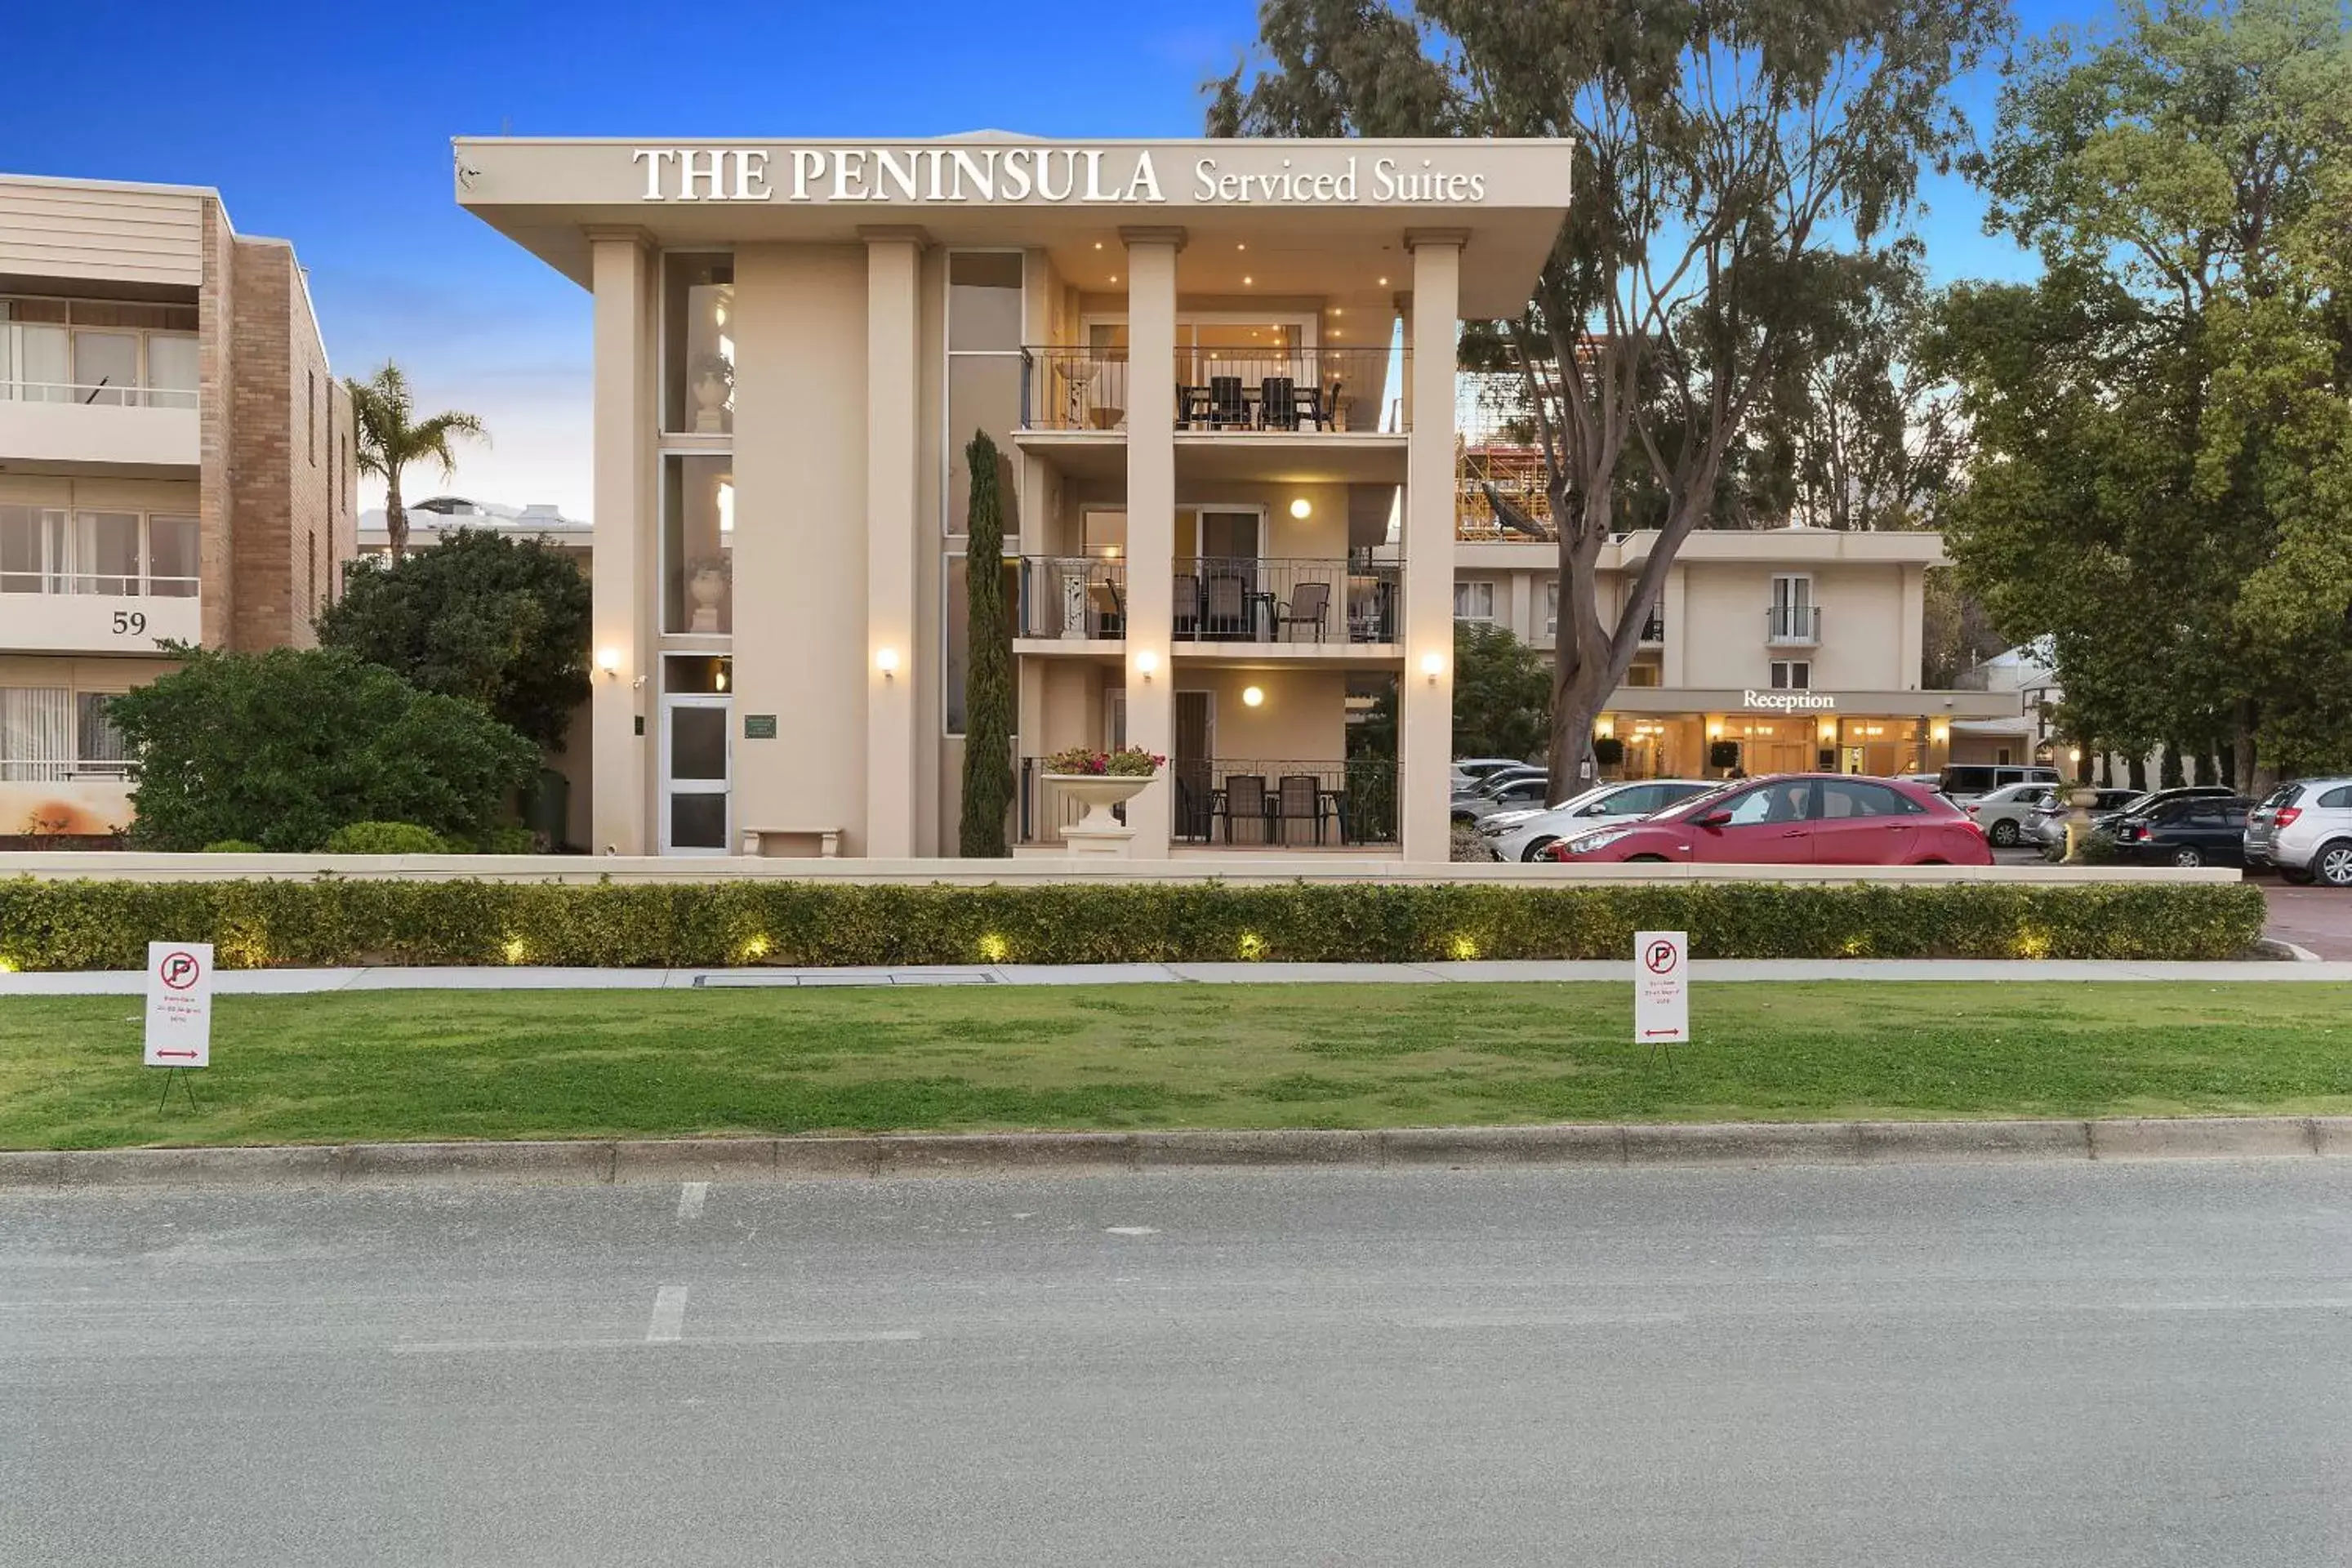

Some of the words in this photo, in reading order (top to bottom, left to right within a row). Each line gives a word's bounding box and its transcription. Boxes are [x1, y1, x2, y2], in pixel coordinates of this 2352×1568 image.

[632, 148, 773, 201] THE
[789, 148, 1166, 202] PENINSULA
[1193, 156, 1359, 202] Serviced
[1372, 158, 1485, 202] Suites
[113, 611, 146, 636] 59
[1743, 689, 1836, 714] Reception
[1655, 947, 1670, 966] P
[172, 960, 191, 982] P
